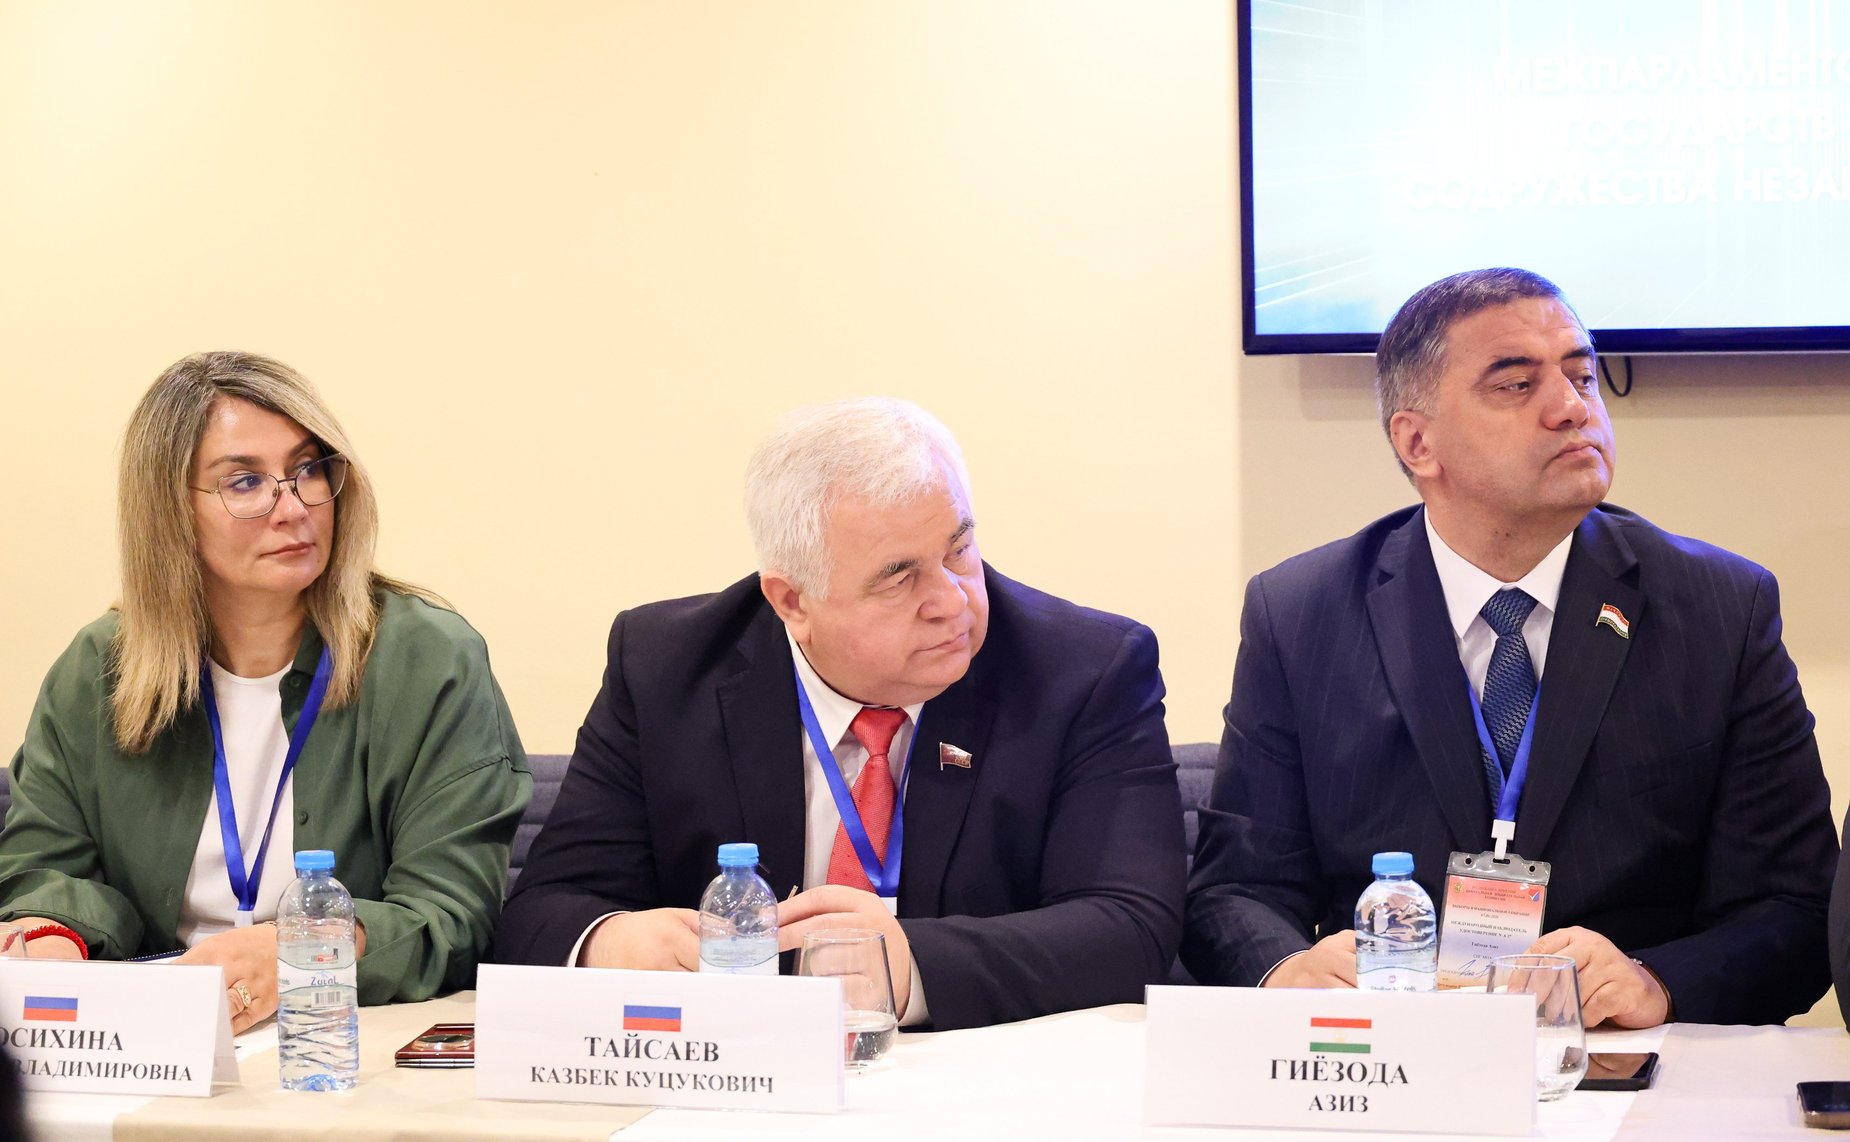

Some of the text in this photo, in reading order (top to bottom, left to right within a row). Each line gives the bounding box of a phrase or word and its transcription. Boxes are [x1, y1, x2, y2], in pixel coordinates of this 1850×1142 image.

[1566, 107, 1836, 147] ГОСУДАРСТВ
[1406, 167, 1850, 210] СОДРУЖЕСТВА НЕЗА
[584, 1033, 720, 1062] ТАЙСАЕВ
[530, 1066, 774, 1094] КАЗБЕК КУЦУКОВИЧ
[1269, 1055, 1409, 1087] ГИЁЗОДА
[1308, 1094, 1368, 1112] АЗИЗ
